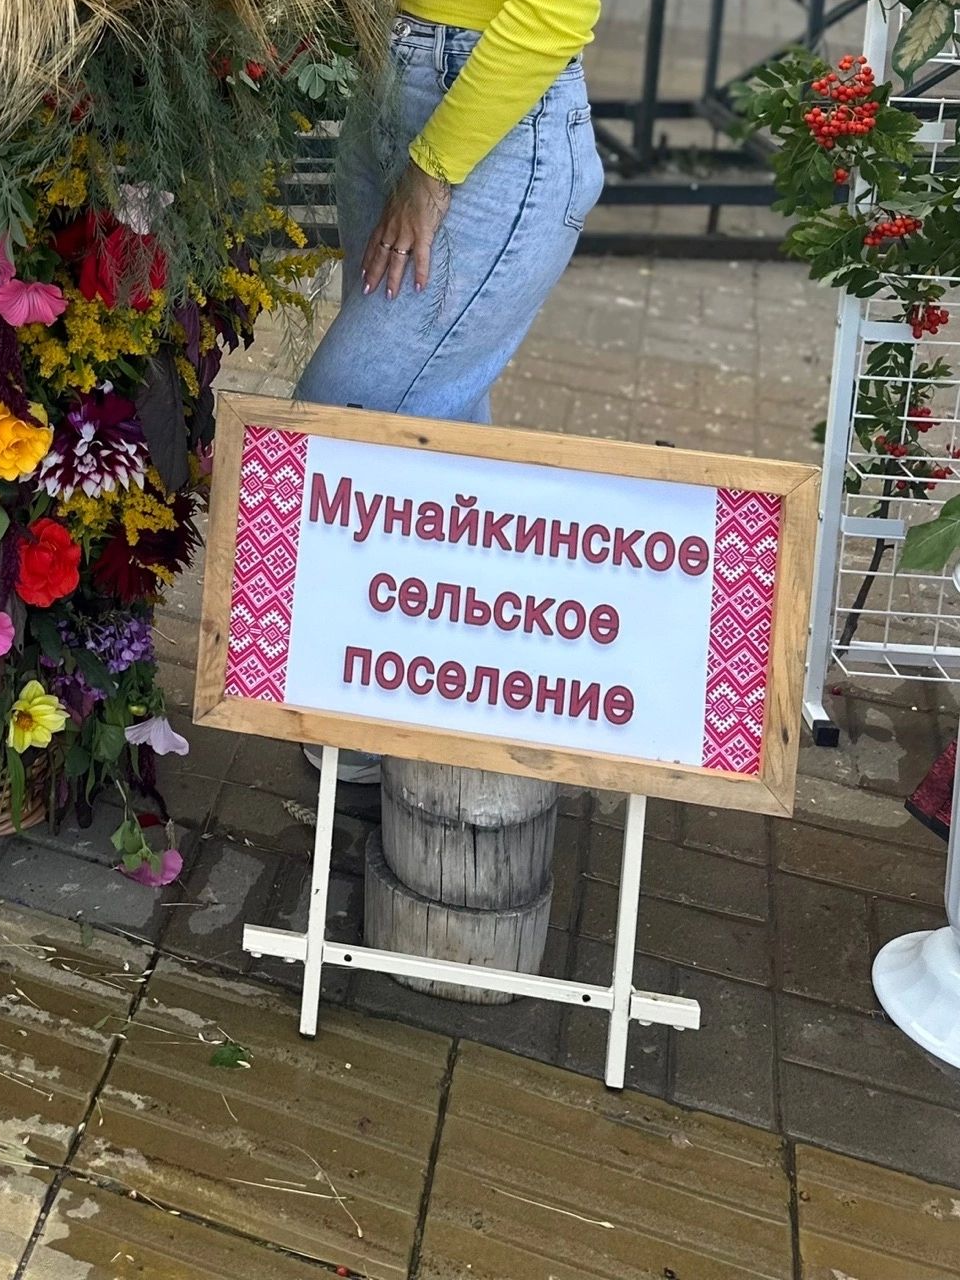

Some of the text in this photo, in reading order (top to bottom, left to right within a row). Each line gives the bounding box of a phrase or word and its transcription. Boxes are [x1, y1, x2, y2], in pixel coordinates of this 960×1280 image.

[308, 472, 711, 577] Мунайкинское
[368, 572, 620, 645] сельское
[342, 645, 635, 726] поселение
